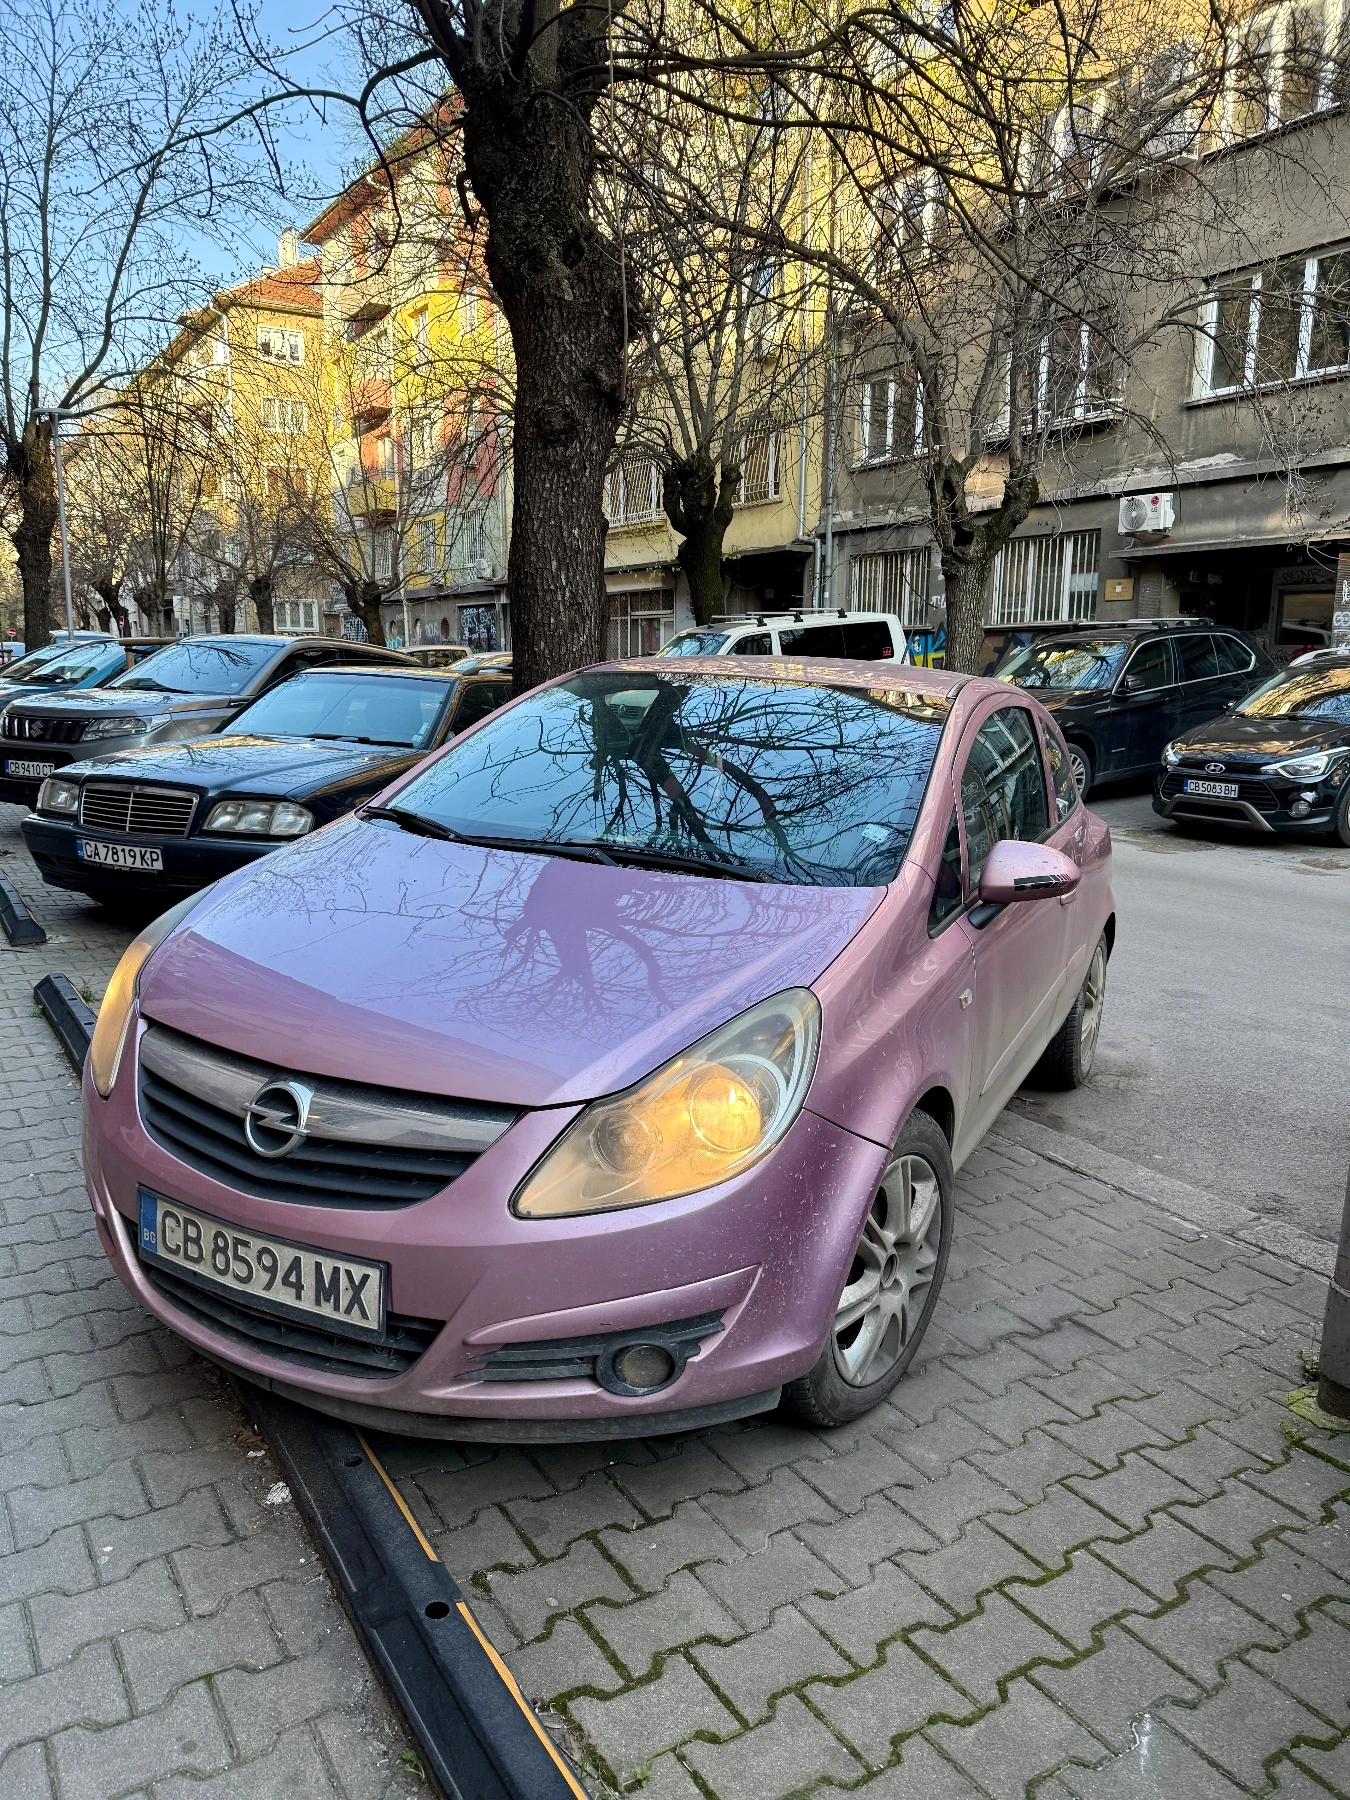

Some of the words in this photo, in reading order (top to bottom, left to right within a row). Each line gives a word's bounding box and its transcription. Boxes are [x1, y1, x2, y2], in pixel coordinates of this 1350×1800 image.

[10, 761, 20, 774] CB
[20, 762, 41, 776] 9410
[42, 764, 54, 777] CT
[1188, 781, 1200, 792] CB
[1201, 782, 1223, 795] 5083
[1223, 785, 1237, 797] BH
[84, 841, 102, 861] CA
[102, 844, 137, 866] 7819
[139, 848, 160, 868] KP
[143, 1228, 156, 1244] BG
[161, 1209, 205, 1265] CB
[211, 1229, 306, 1302] 8594
[314, 1259, 372, 1321] MX
